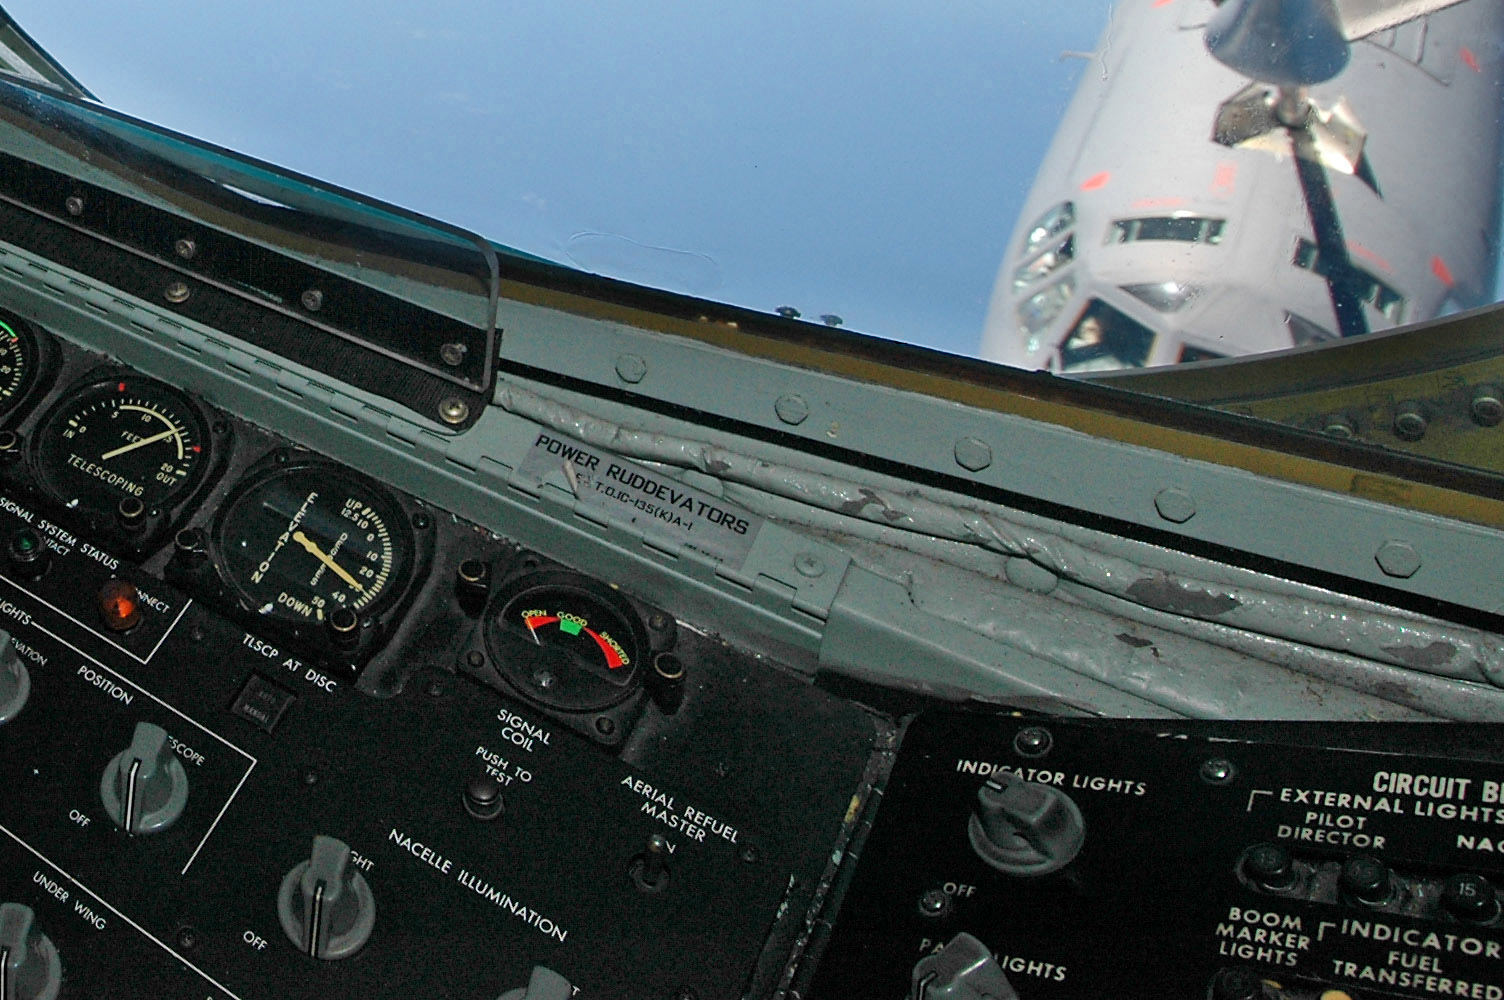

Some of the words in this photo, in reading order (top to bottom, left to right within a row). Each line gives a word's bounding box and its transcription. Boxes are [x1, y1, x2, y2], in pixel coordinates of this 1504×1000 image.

[0, 365, 11, 374] 20
[111, 411, 120, 419] 5
[141, 414, 152, 423] 10
[62, 429, 75, 439] IN
[79, 426, 87, 434] 0
[67, 453, 144, 497] TELESCOPING
[156, 472, 178, 487] OUT
[160, 463, 174, 473] 20
[535, 434, 600, 471] POWER
[606, 463, 750, 535] RUDDEVATORS
[341, 507, 359, 522] 12.5
[345, 498, 363, 511] UP
[356, 519, 369, 530] 10
[37, 519, 77, 546] SYSTEM
[80, 544, 119, 570] STATUS
[366, 533, 375, 542] 0
[366, 550, 378, 561] 10
[359, 566, 374, 578] 20
[277, 592, 313, 617] DOWN
[311, 595, 326, 608] 50
[331, 591, 346, 603] 40
[520, 609, 548, 619] OPEN
[556, 611, 588, 628] GOOD
[600, 630, 630, 665] SHORTED
[243, 633, 280, 660] TLSCP
[282, 657, 303, 673] AT
[304, 668, 338, 694] DISC
[77, 665, 134, 706] POSITION
[497, 708, 552, 746] SIGNAL
[501, 727, 534, 753] COIL
[476, 746, 509, 770] PUSH
[514, 764, 533, 783] TO
[484, 764, 513, 787] TEST
[1073, 775, 1147, 796] LIGHTS
[1373, 771, 1472, 800] CIRCUIT
[621, 776, 675, 811] AERIAL
[684, 805, 739, 844] REFUEL
[1280, 788, 1404, 814] EXTERNAL
[1414, 800, 1504, 824] LIGHTS
[68, 809, 91, 828] OFF
[641, 802, 706, 843] MASTER
[1305, 811, 1368, 830] PILOT
[1277, 825, 1386, 850] DIRECTOR
[388, 829, 453, 875] NACELLE
[457, 869, 568, 943] ILLUMINATION
[943, 882, 976, 898] OFF
[1459, 882, 1476, 897] 15
[33, 870, 69, 903] UNDER
[74, 900, 107, 931] WING
[1229, 907, 1302, 931] BOOM
[243, 930, 268, 951] OFF
[1215, 923, 1311, 950] MARKER
[1342, 919, 1502, 960] INDICATOR
[1219, 941, 1298, 966] LIGHTS
[1387, 951, 1443, 974] FUEL
[994, 952, 1068, 982] IGHTS
[1332, 959, 1503, 1000] TRANSFERRED
